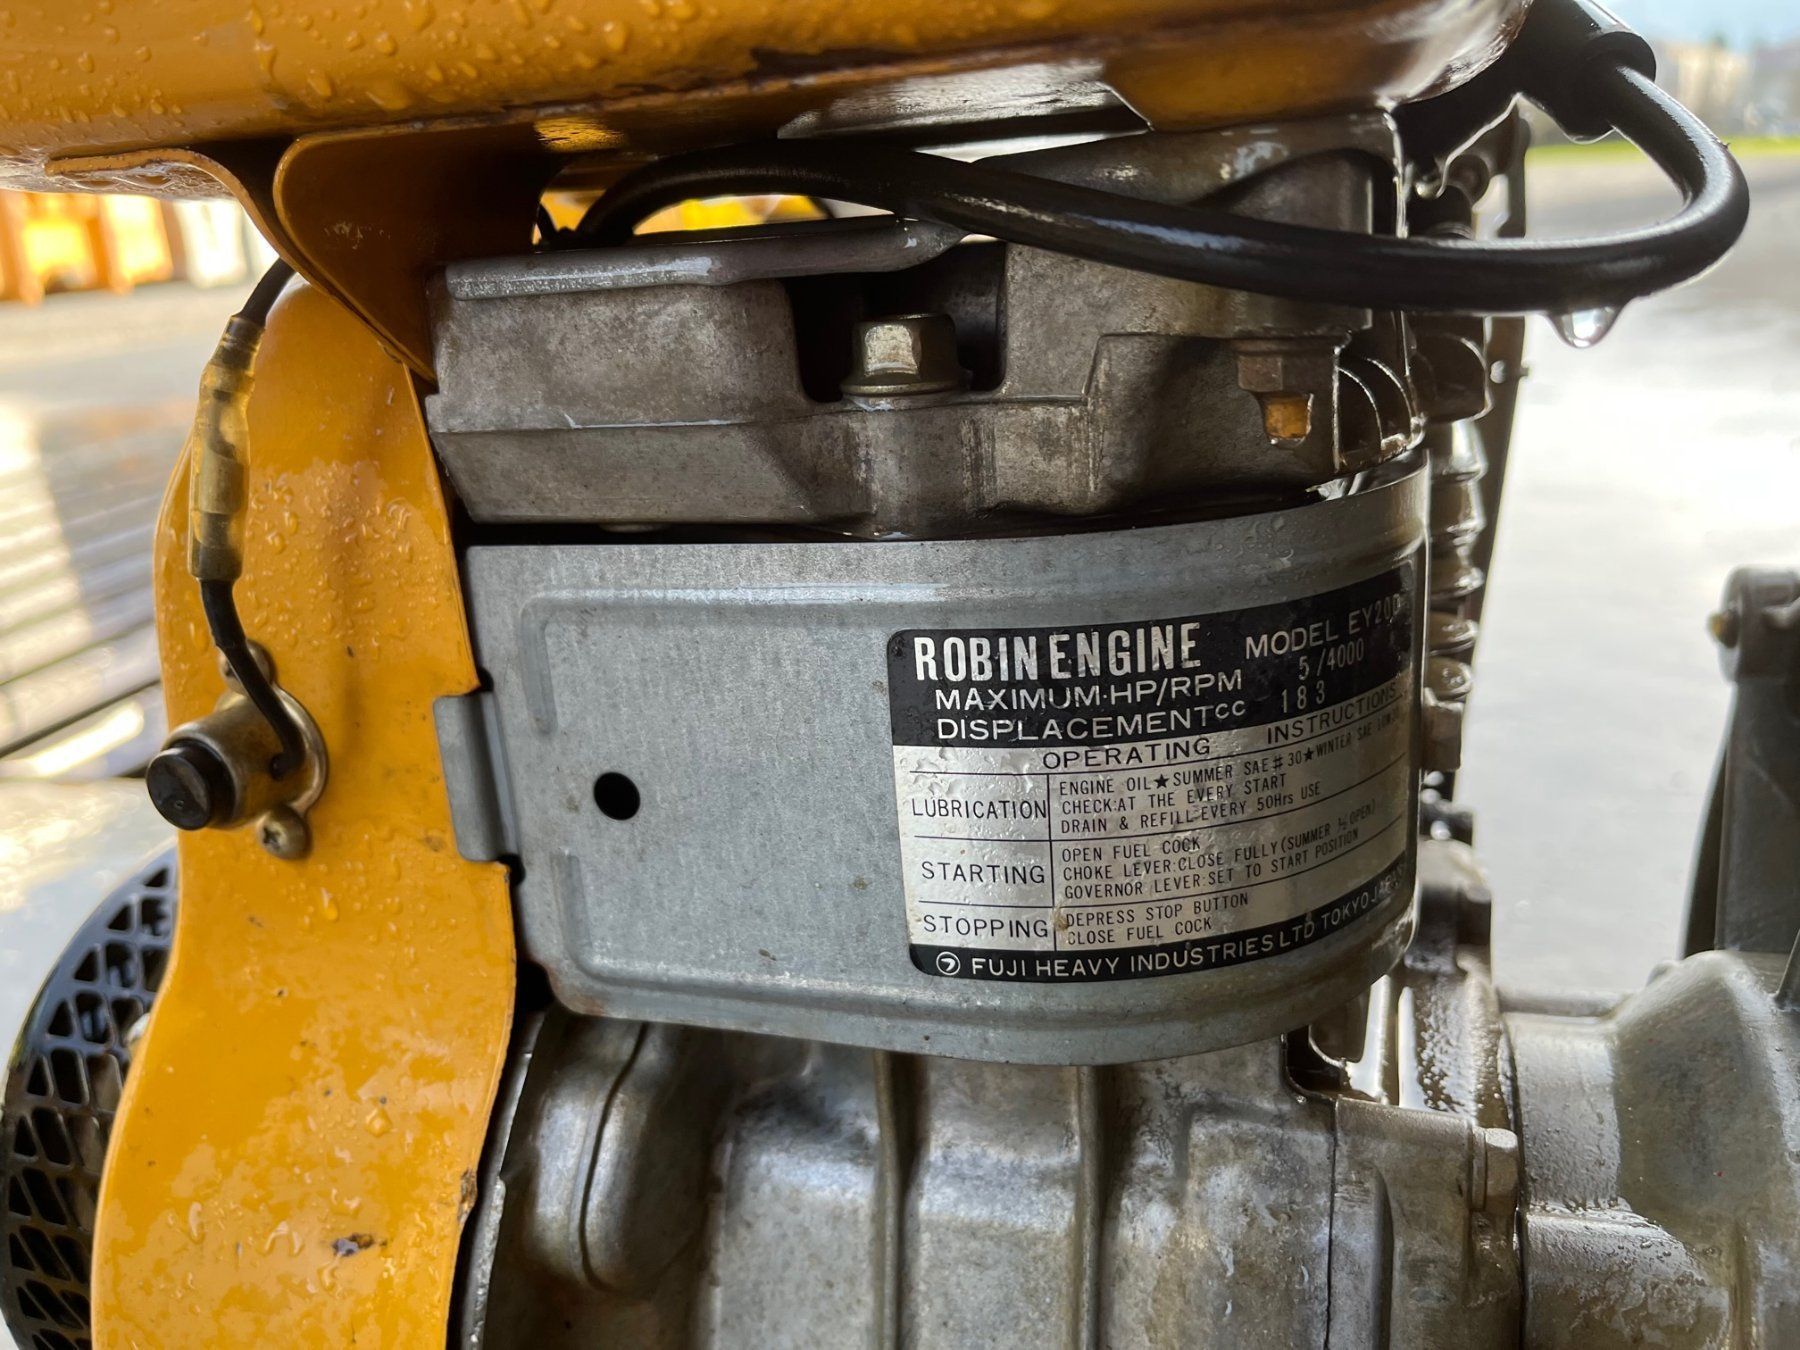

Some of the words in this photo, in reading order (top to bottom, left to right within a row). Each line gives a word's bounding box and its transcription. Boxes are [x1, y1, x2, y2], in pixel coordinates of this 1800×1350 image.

[913, 636, 1038, 682] ROBIN
[1049, 622, 1201, 680] ENGINE
[1245, 620, 1339, 660] MODEL
[1043, 738, 1211, 770] OPERATING
[1267, 682, 1396, 745] INSTRUCTIONS
[1060, 779, 1115, 796] ENGINE
[1126, 776, 1151, 792] OIL
[1173, 764, 1233, 787] SUMMER
[1149, 792, 1175, 808] THE
[1187, 784, 1233, 804] EVERY
[1244, 773, 1287, 795] START
[912, 798, 1047, 819] LUBRICATION
[1061, 818, 1107, 834] DRAIN
[1119, 816, 1129, 831] &
[1257, 793, 1294, 811] 50Hrs
[1301, 781, 1320, 800] USE
[1062, 847, 1102, 863] OPEN
[1113, 843, 1150, 859] FUEL
[1162, 836, 1201, 855] COCK
[1064, 881, 1143, 900] GOVERNOR
[1245, 863, 1262, 878] TO
[1271, 850, 1309, 873] START
[1315, 828, 1359, 859] POSITION
[921, 861, 1045, 884] STARTING
[1063, 866, 1113, 881] CHOKE
[923, 914, 1048, 938] STOPPING
[1066, 909, 1135, 927] DEPRESS
[1146, 903, 1183, 921] STOP
[1193, 892, 1249, 915] BUTTON
[971, 957, 1026, 976] FUJI
[1036, 957, 1120, 977] HEAVY
[1131, 934, 1274, 972] INDUSTRIES
[1279, 921, 1315, 948] LTD
[1321, 891, 1368, 930] TOKYO
[1067, 928, 1115, 945] CLOSE
[1127, 925, 1164, 941] FUEL
[1174, 916, 1213, 936] COCK
